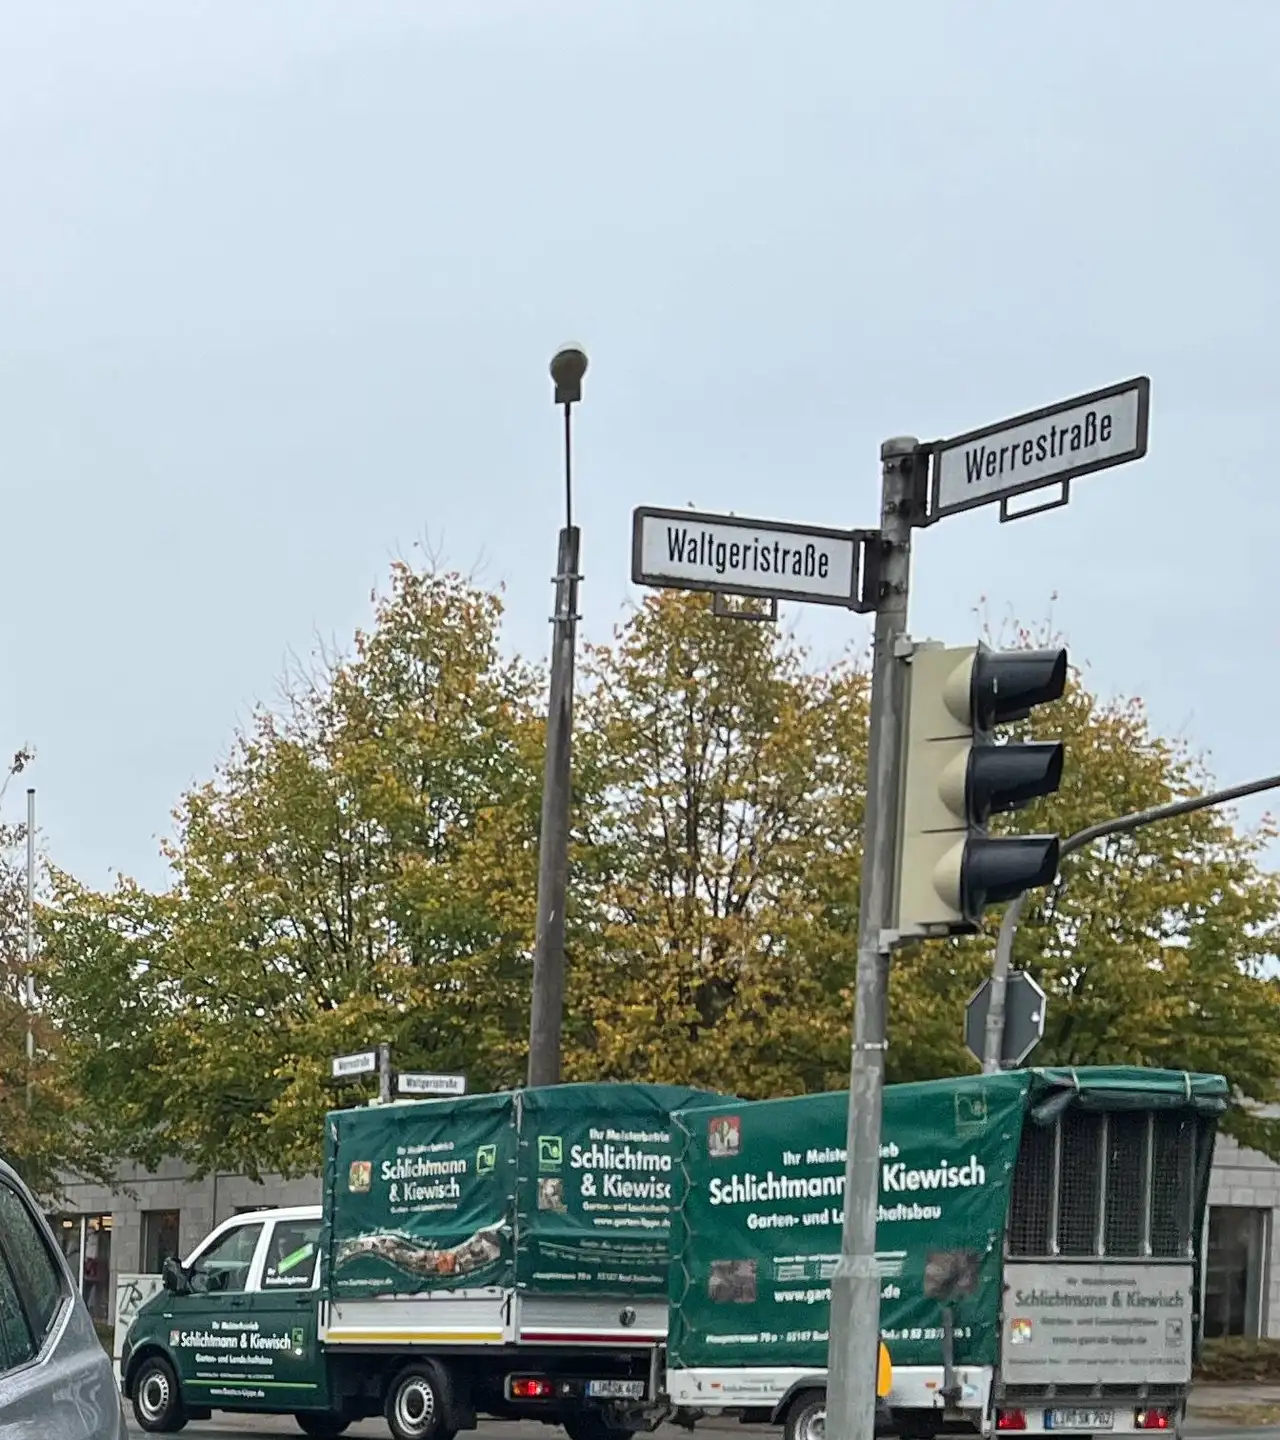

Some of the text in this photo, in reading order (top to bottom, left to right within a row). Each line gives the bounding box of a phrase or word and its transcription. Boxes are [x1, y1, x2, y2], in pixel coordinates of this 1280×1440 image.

[964, 410, 1113, 485] Werrestraße
[666, 526, 830, 579] Waltgeristraße
[381, 1157, 467, 1181] Schlichtmann
[570, 1143, 671, 1171] Schlichtma
[783, 1151, 801, 1165] Ihr
[580, 1173, 598, 1197] &
[882, 1155, 986, 1192] Kiewisch
[389, 1176, 460, 1202] & Kiewisch
[747, 1212, 799, 1229] Garten-
[803, 1208, 830, 1226] und
[181, 1329, 291, 1350] Schlichtmann & Kiewisch
